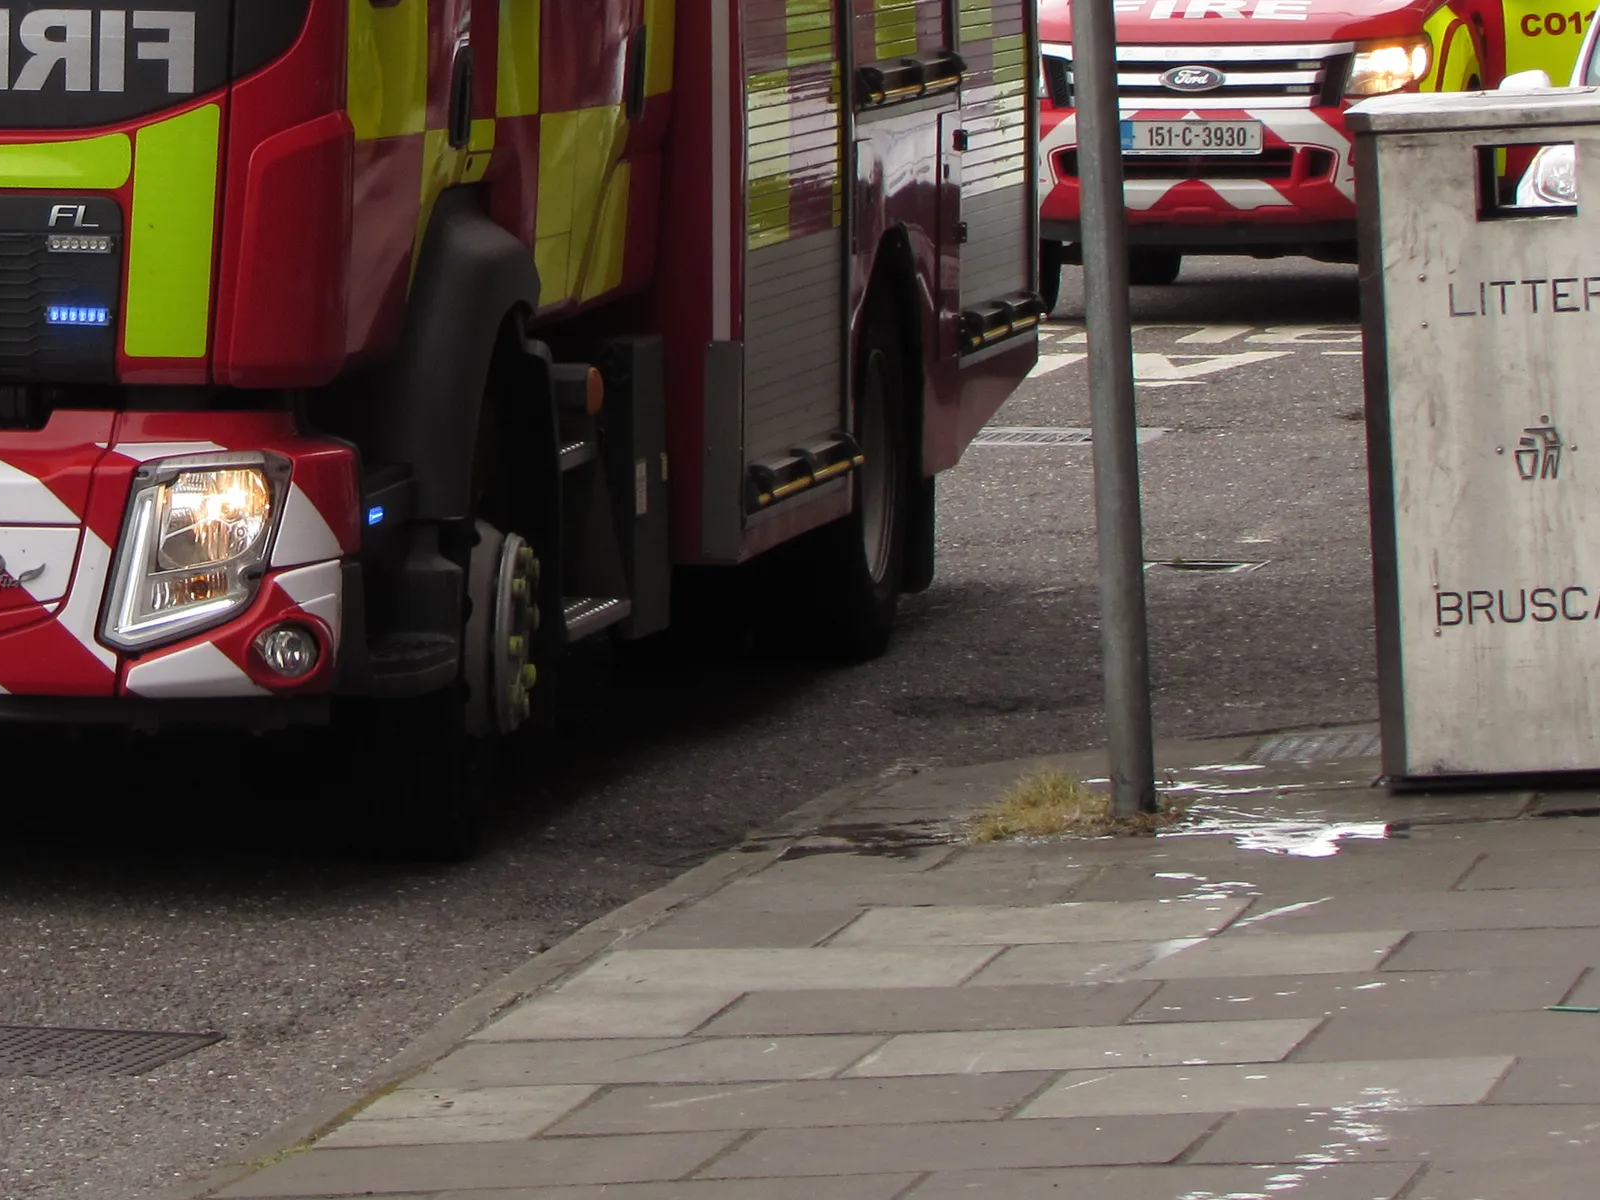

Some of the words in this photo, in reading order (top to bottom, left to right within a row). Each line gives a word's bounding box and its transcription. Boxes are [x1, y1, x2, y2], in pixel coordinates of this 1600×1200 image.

[1174, 69, 1211, 85] Ford
[1147, 126, 1247, 147] 151-C-3930
[47, 204, 100, 228] FL
[1435, 586, 1600, 627] BRUSC
